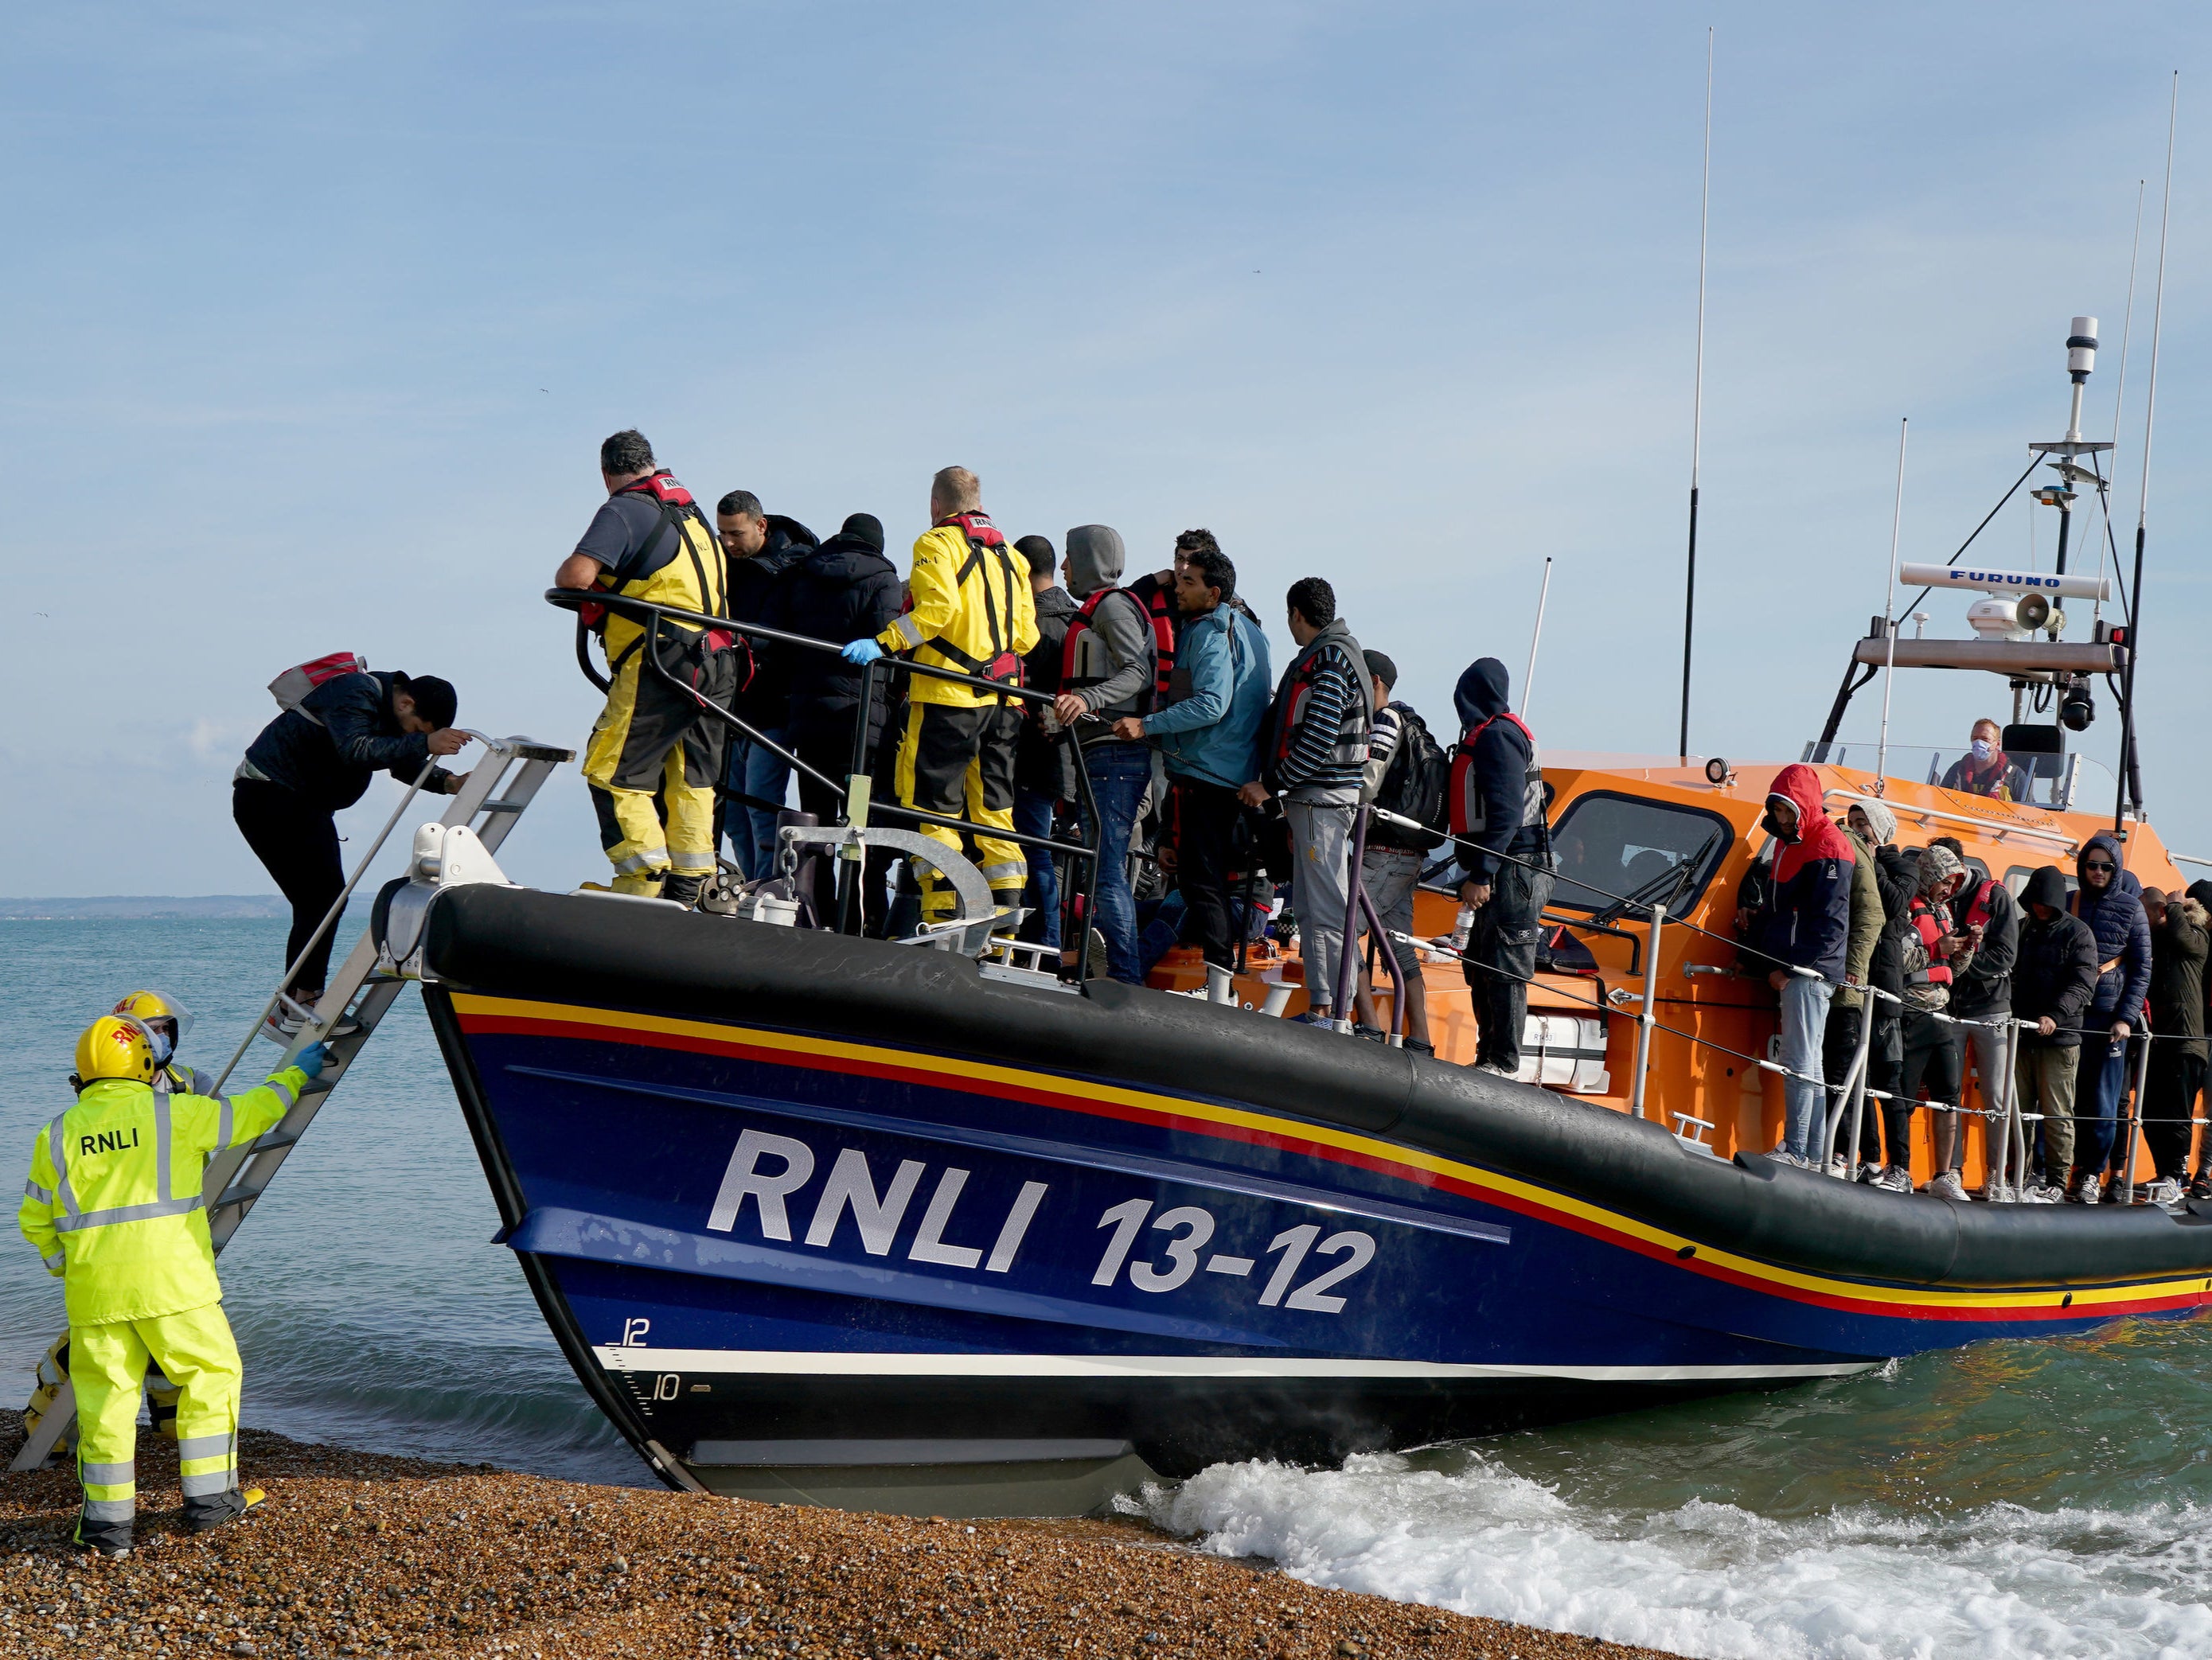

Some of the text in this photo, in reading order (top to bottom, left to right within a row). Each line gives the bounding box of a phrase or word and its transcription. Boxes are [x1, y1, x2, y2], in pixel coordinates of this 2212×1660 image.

[696, 541, 710, 551] NLI
[915, 556, 938, 567] RNI
[1950, 571, 2060, 587] FURUNO
[80, 1128, 138, 1156] RNLI
[707, 1128, 1376, 1314] RNLI 13-12
[622, 1318, 650, 1346] 12
[653, 1374, 681, 1401] 10
